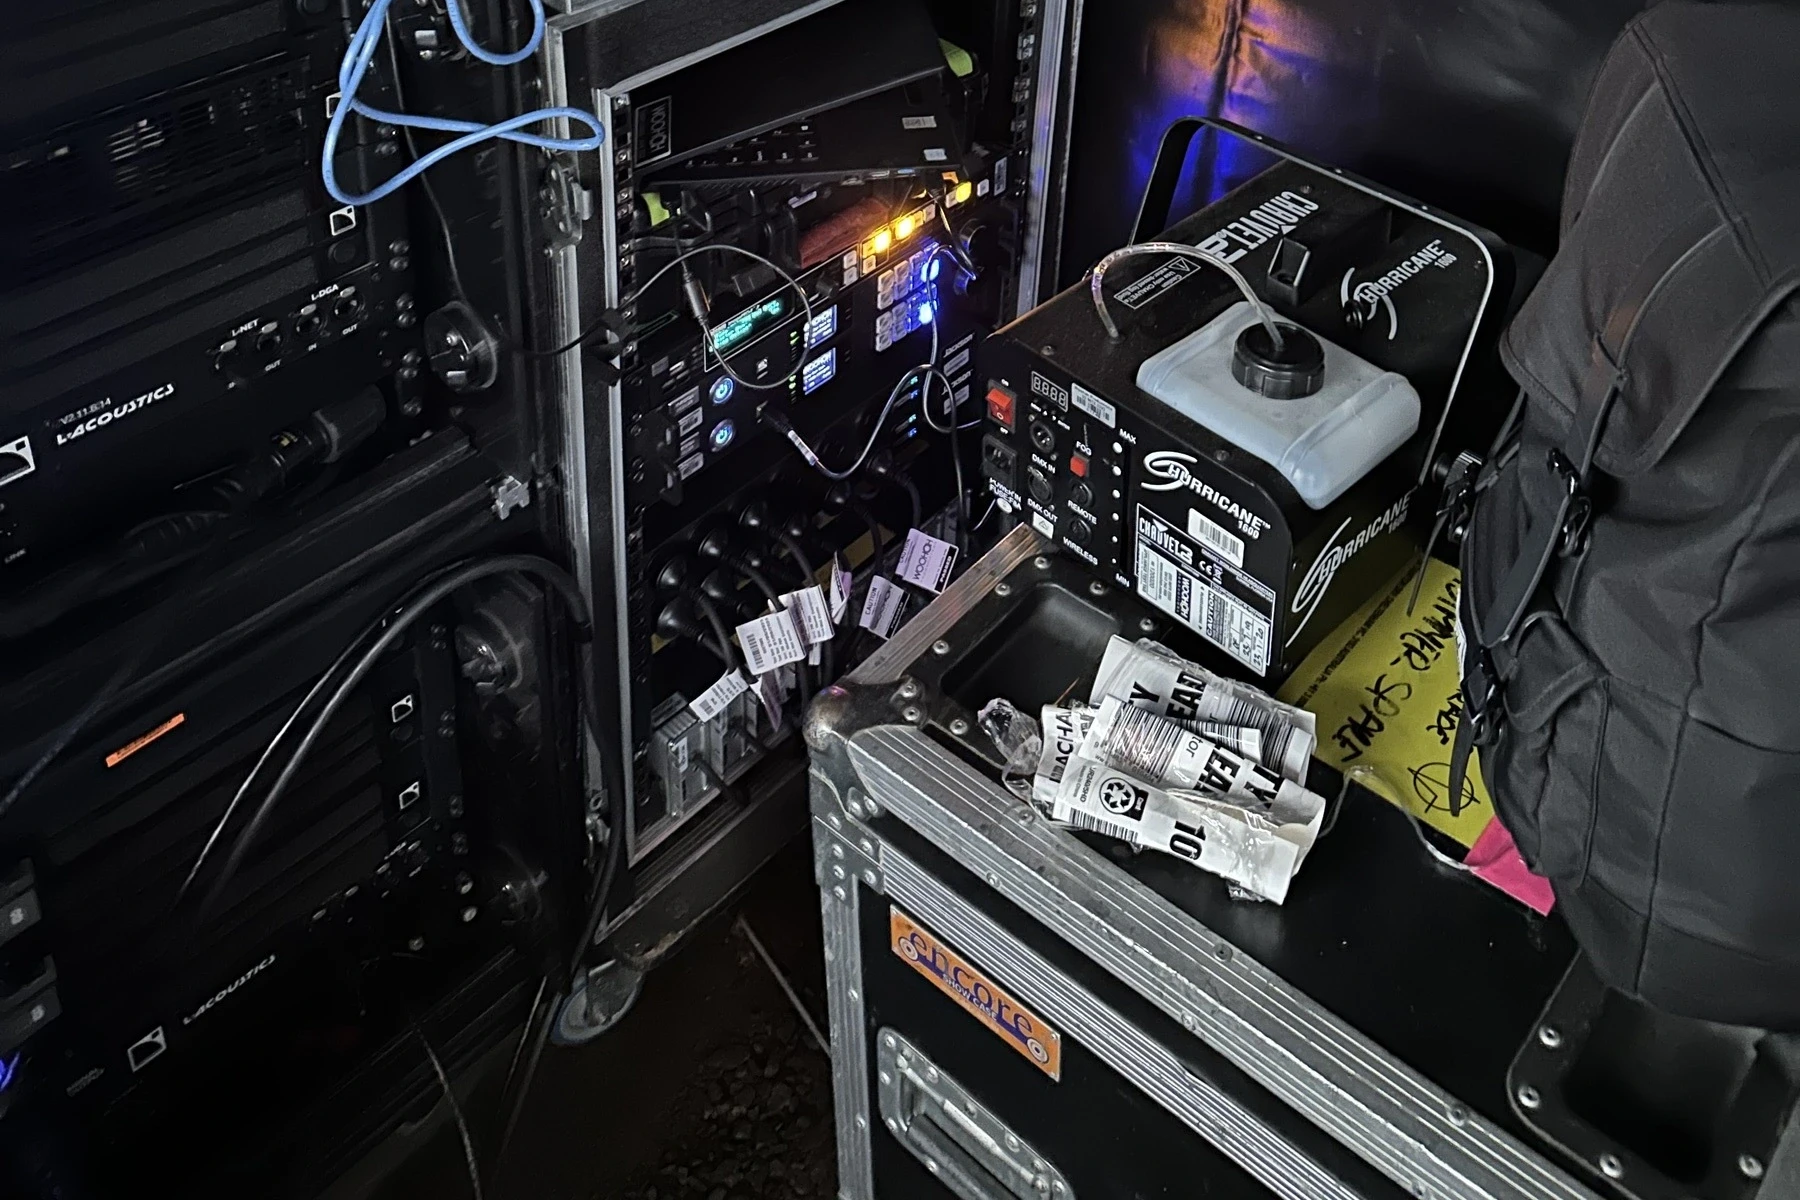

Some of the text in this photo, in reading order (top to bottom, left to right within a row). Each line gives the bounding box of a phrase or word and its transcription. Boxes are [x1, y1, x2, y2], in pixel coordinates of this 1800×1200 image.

[1228, 190, 1320, 249] CHAUVET
[1358, 245, 1446, 303] HURRICANE
[231, 318, 259, 337] L-NET
[1076, 441, 1092, 456] FOG
[1119, 429, 1136, 444] MAX
[1032, 454, 1056, 474] DMX IN
[1027, 498, 1058, 523] DMX OUT
[1068, 500, 1098, 524] REMOTE
[1167, 463, 1263, 531] HURRICANE
[1139, 516, 1181, 554] CHAUVET
[1238, 520, 1260, 540] 1600
[1318, 495, 1410, 584] HURRICANE
[1063, 536, 1098, 566] WIRELESS
[1116, 573, 1130, 587] MIN
[1206, 591, 1216, 637] CAUTION
[1332, 675, 1412, 762] SPARE
[1169, 820, 1207, 861] 10
[909, 932, 1033, 1034] encore
[942, 973, 999, 1022] SHOW CASE
